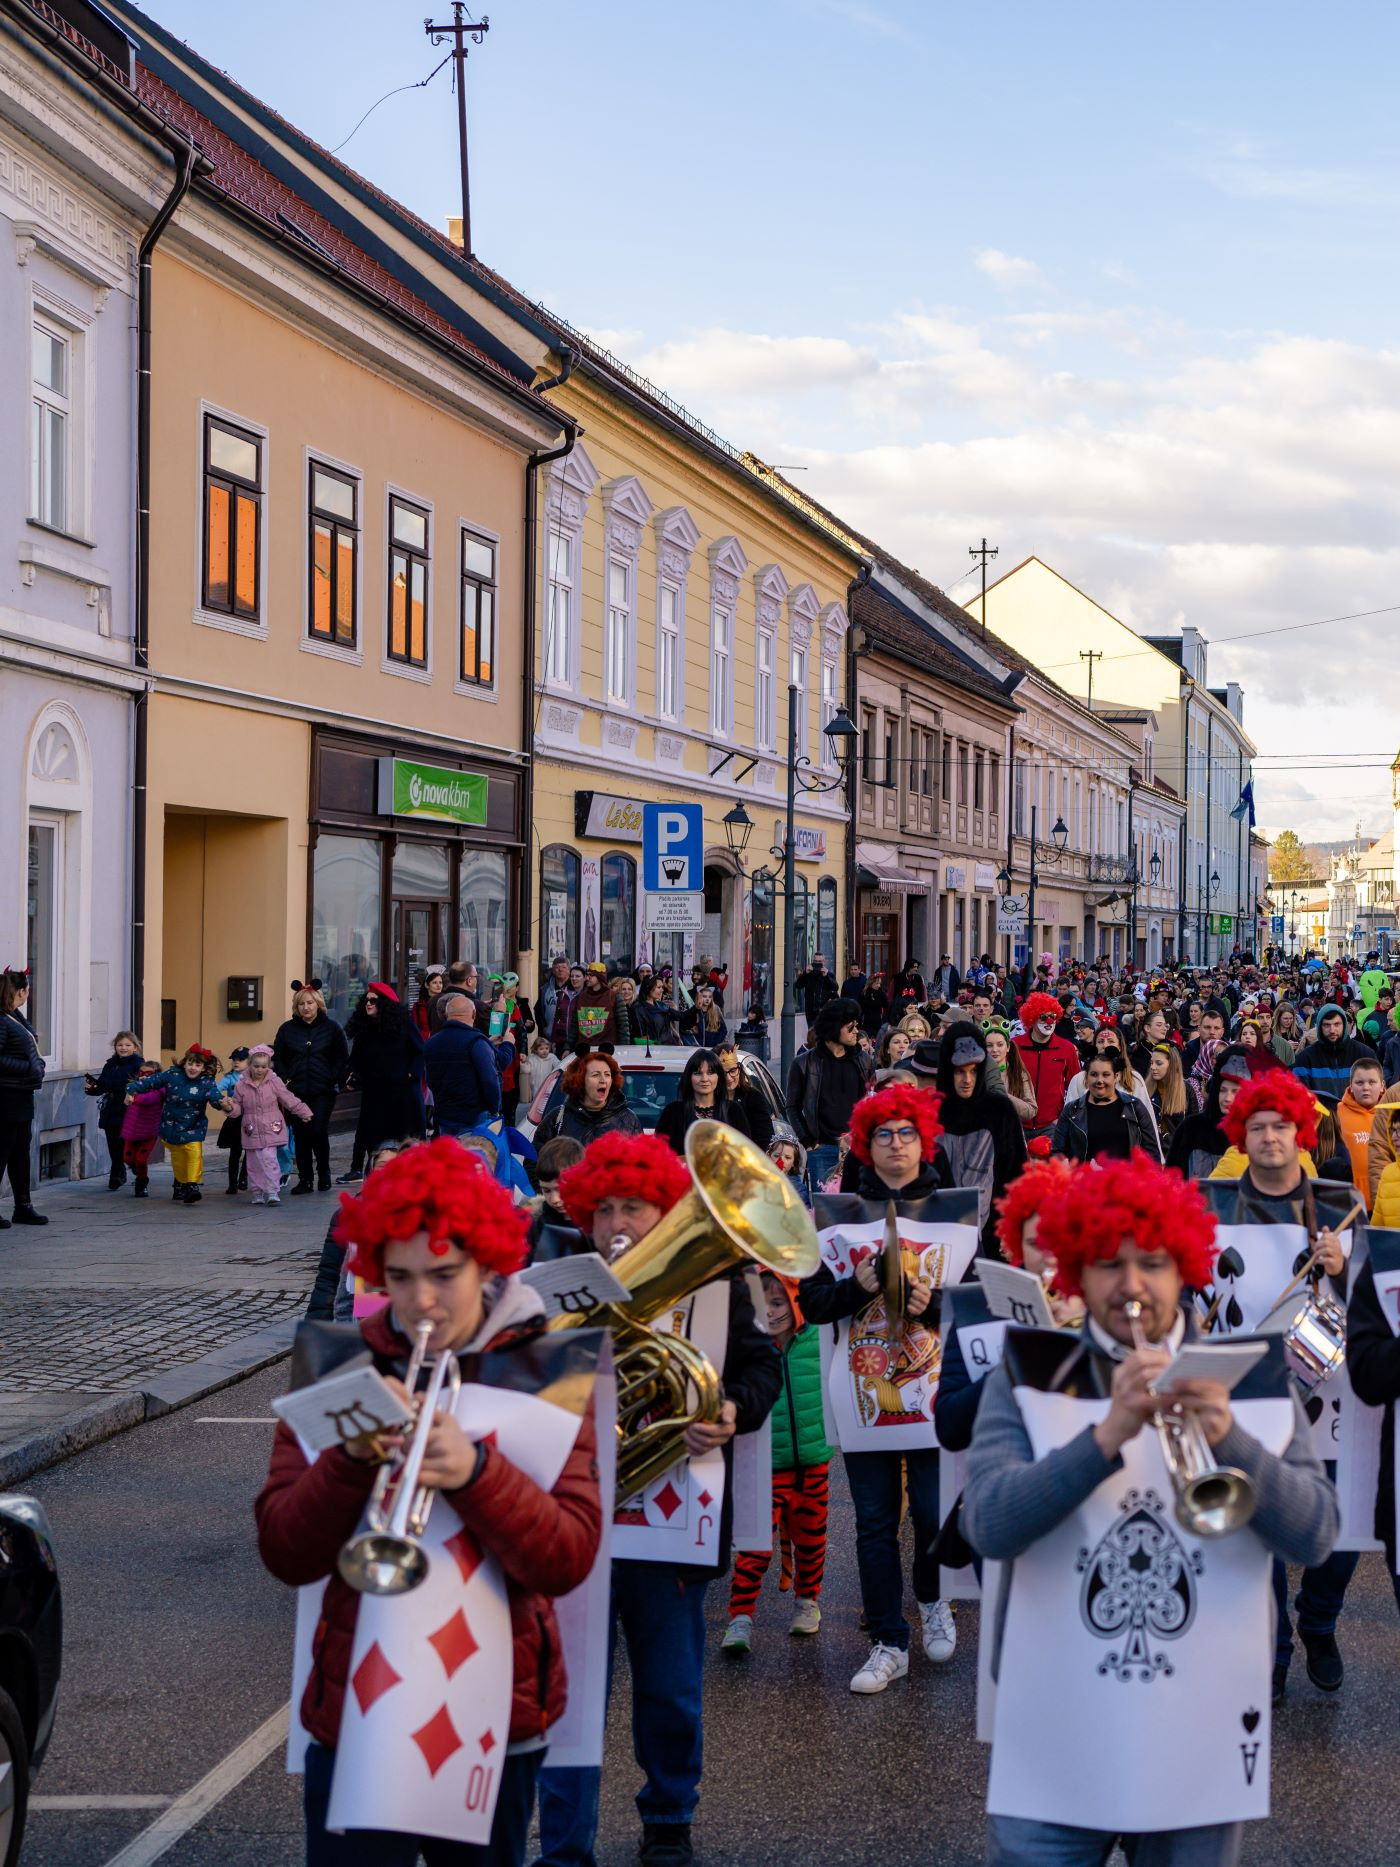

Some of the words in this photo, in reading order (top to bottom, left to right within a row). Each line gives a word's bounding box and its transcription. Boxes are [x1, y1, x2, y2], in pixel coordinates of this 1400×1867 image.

[658, 812, 689, 854] P
[998, 924, 1020, 932] GALA
[827, 1238, 839, 1261] J
[969, 1337, 991, 1366] Q
[1239, 1742, 1261, 1787] A
